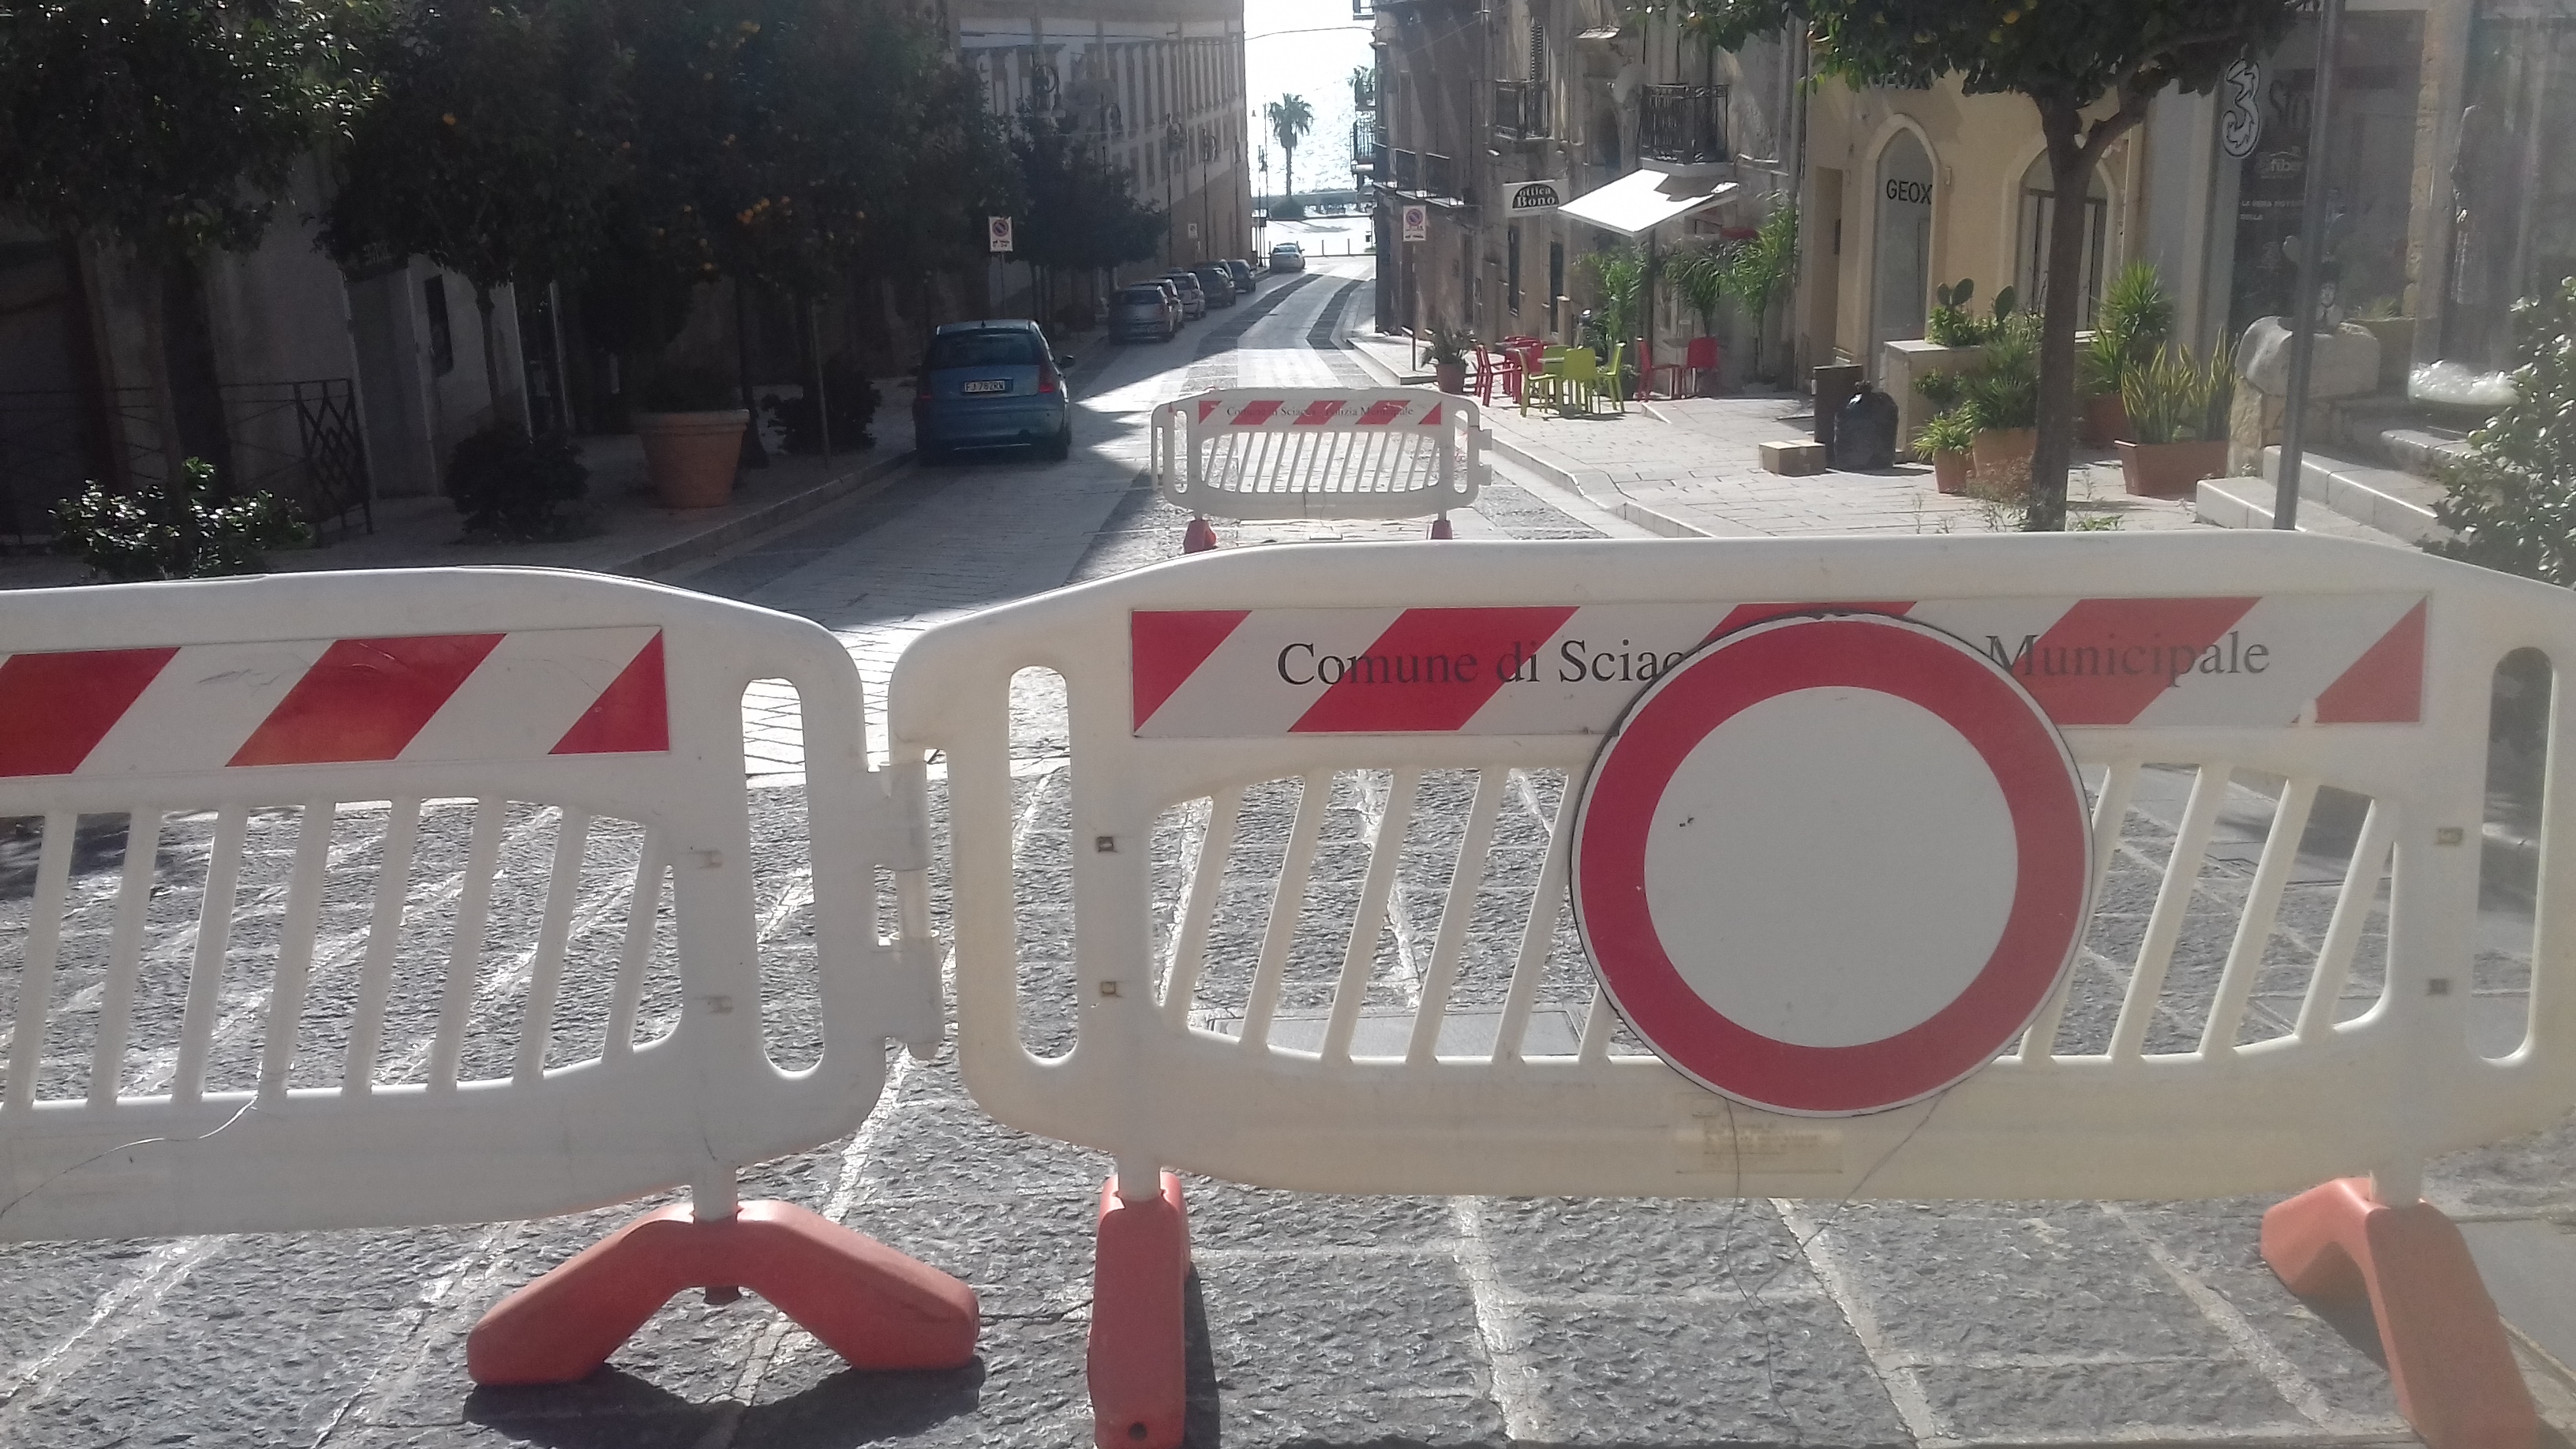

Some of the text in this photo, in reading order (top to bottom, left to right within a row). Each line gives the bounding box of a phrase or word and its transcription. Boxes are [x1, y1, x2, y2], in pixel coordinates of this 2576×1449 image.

[1517, 197, 1555, 207] Bono
[1519, 186, 1551, 197] ottica
[1886, 178, 1933, 205] GEOX
[1277, 638, 1684, 685] Comune di Sciac
[1986, 631, 2271, 687] Municipale
